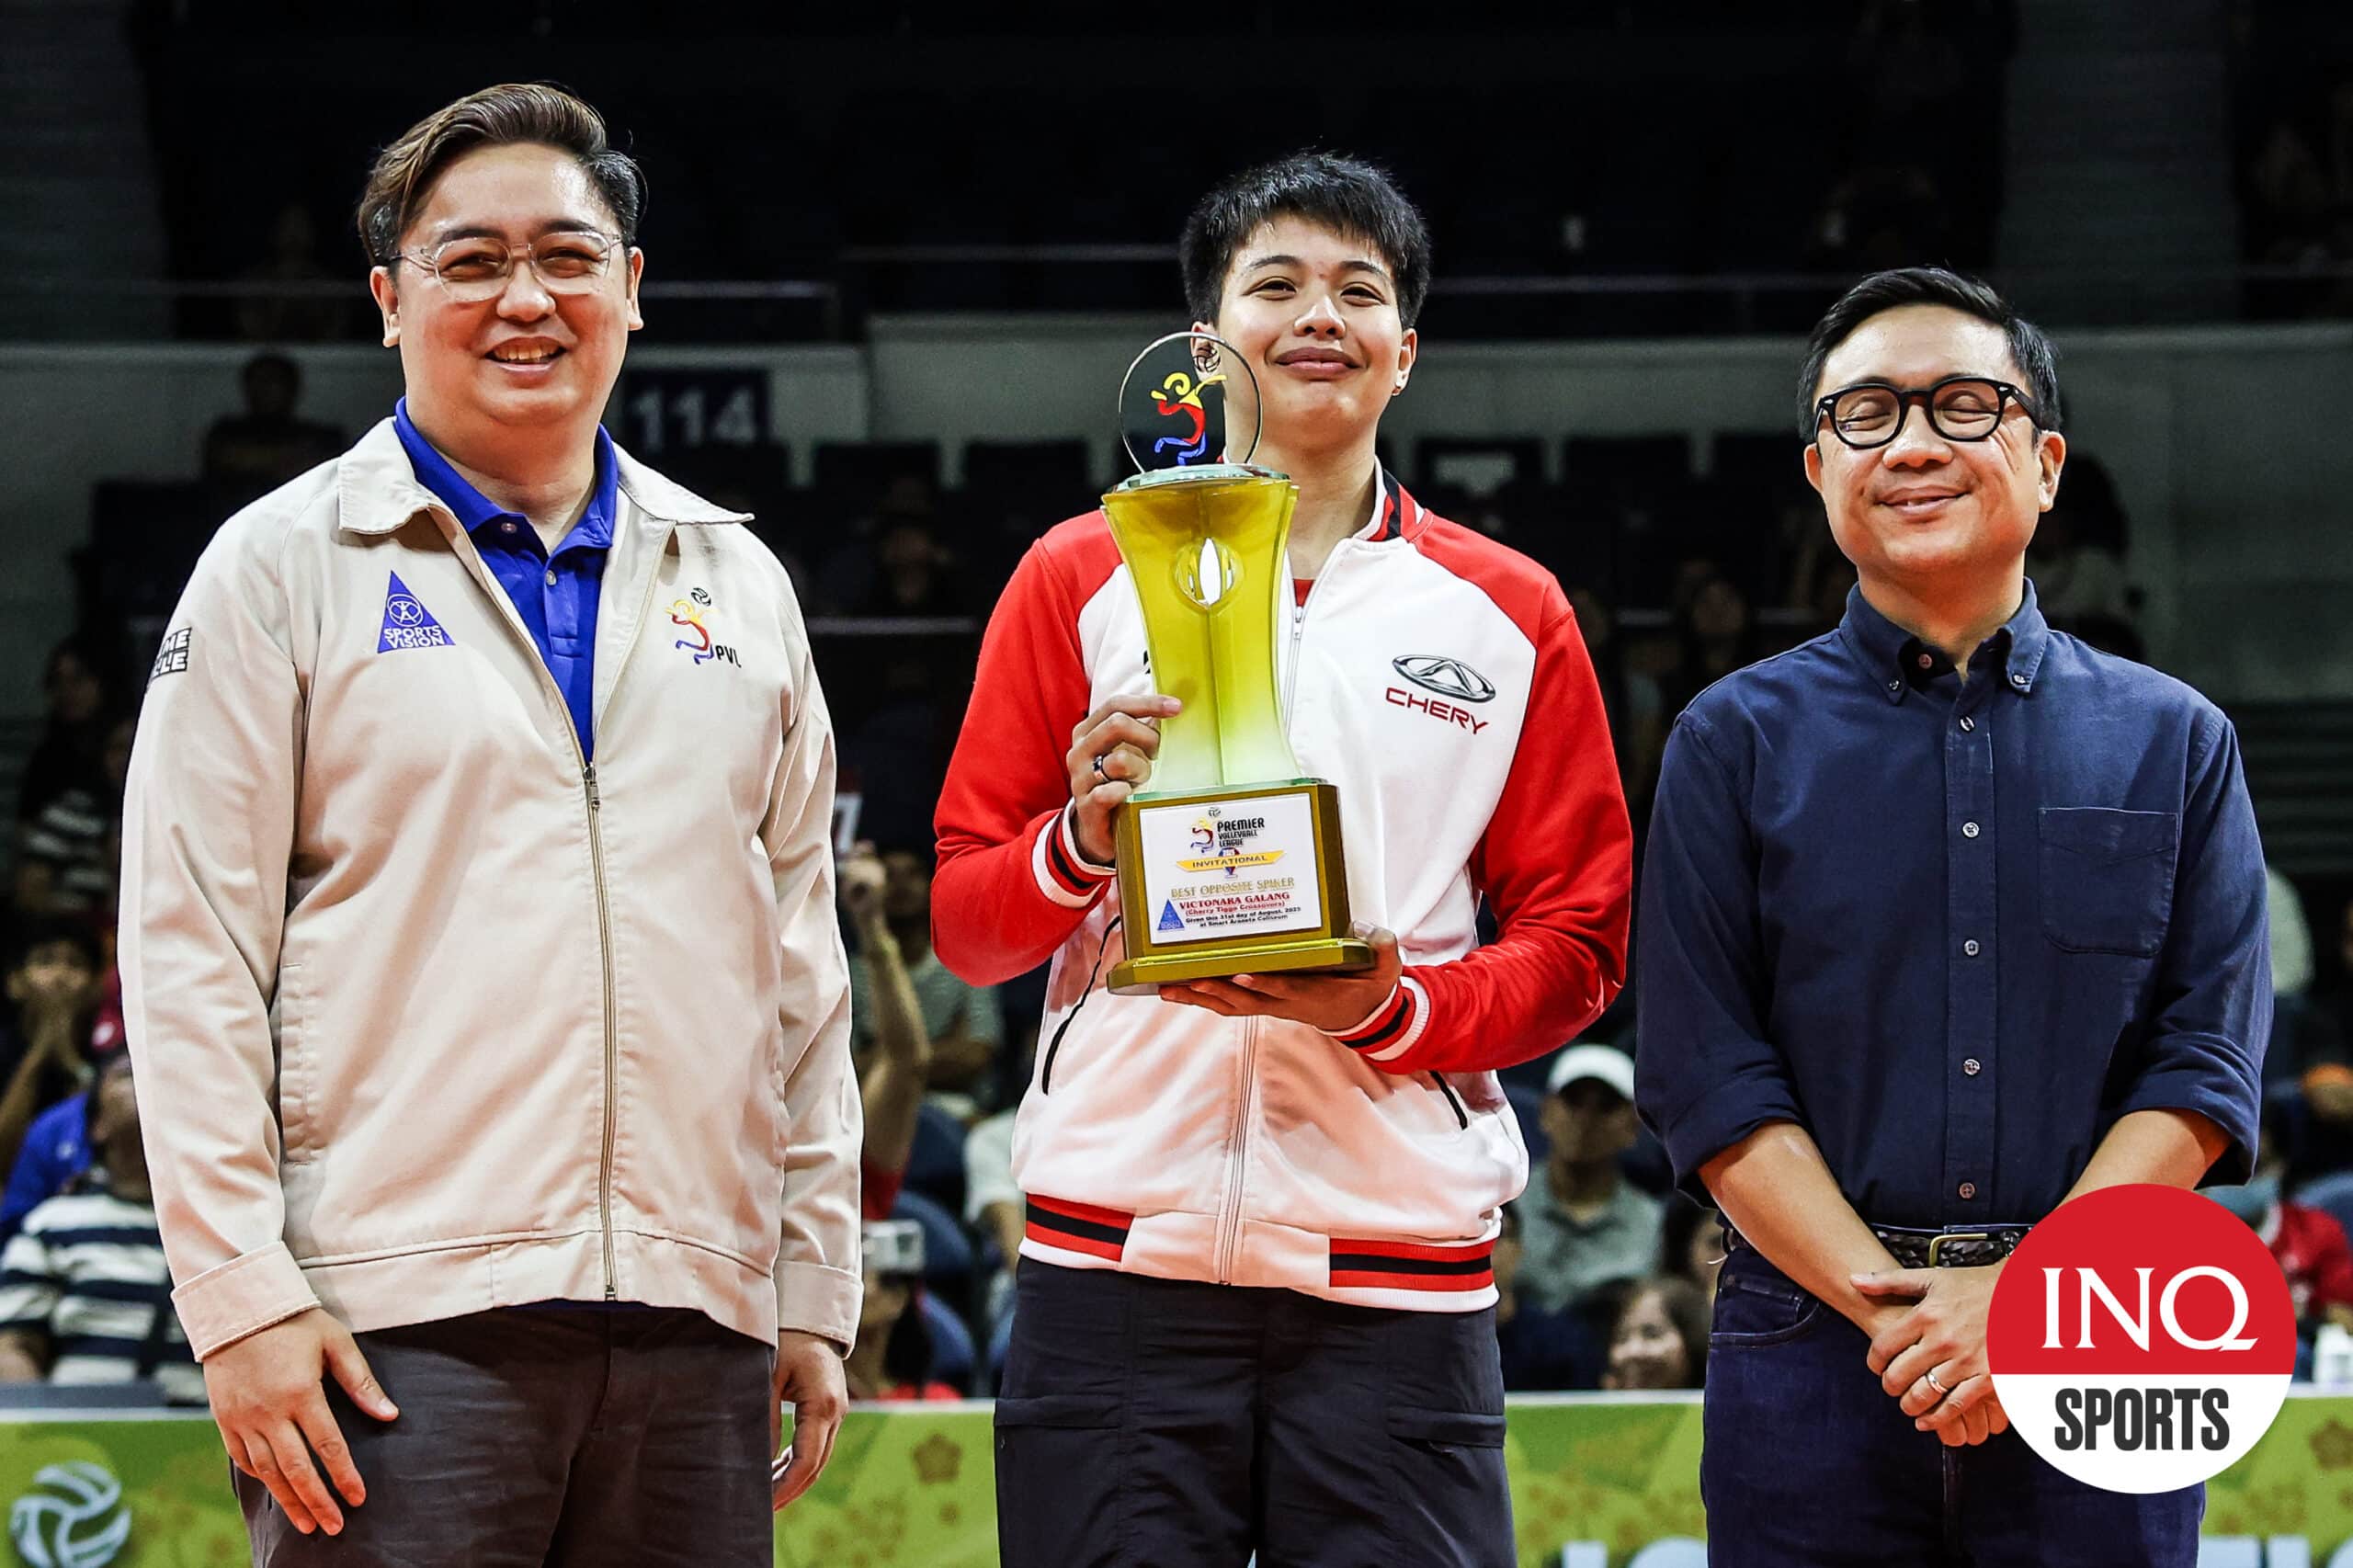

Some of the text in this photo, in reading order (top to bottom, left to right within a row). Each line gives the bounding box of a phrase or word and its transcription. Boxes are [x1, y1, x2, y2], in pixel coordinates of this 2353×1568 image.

[627, 385, 756, 452] 114
[384, 625, 441, 640] SPORTS
[387, 636, 444, 649] VISION
[715, 644, 742, 668] PVL
[1386, 687, 1489, 734] CHERY
[1217, 817, 1265, 832] PREMIER
[1218, 830, 1258, 840] VOLLEYBALL
[1219, 838, 1244, 847] LEAGUE
[1192, 855, 1268, 868] INVITATIONAL
[1171, 877, 1295, 898] BEST OPPOSITE SPIKER
[1245, 892, 1290, 903] GALANG
